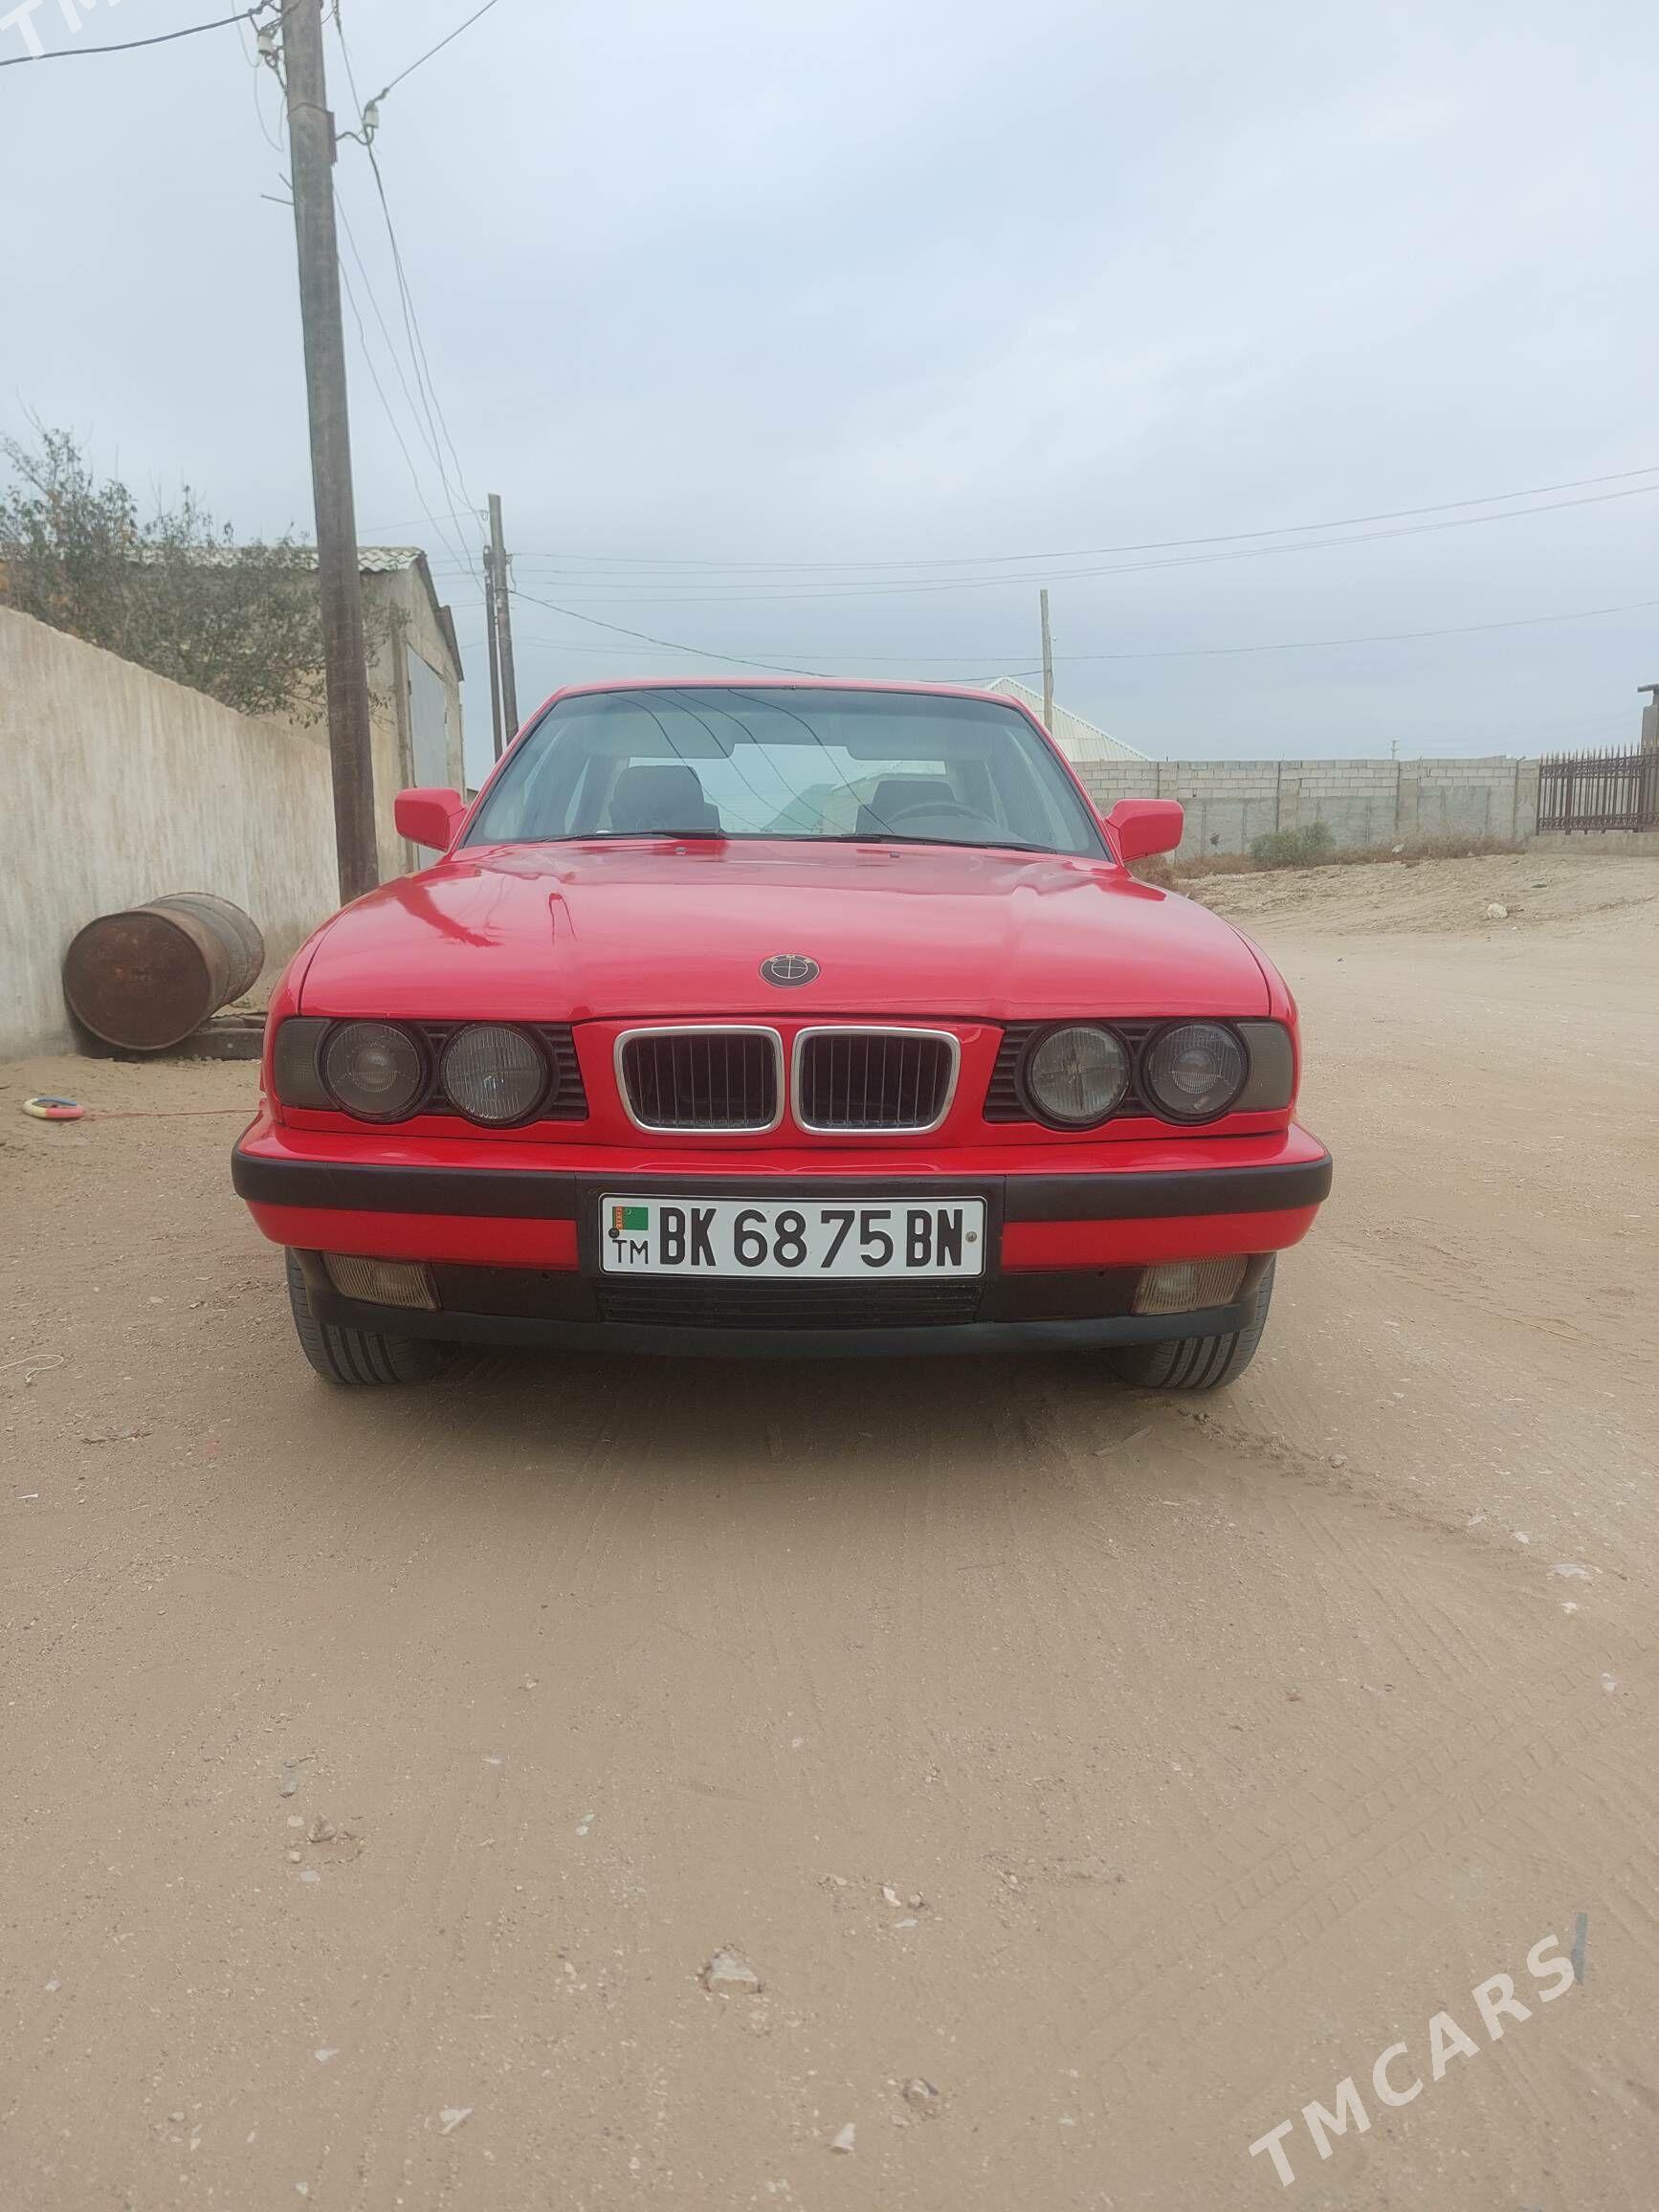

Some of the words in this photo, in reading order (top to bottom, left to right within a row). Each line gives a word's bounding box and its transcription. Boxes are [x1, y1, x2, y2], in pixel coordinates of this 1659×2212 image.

[611, 1238, 650, 1265] TM
[659, 1206, 717, 1267] BK
[733, 1208, 895, 1269] 6875
[905, 1208, 963, 1268] BN
